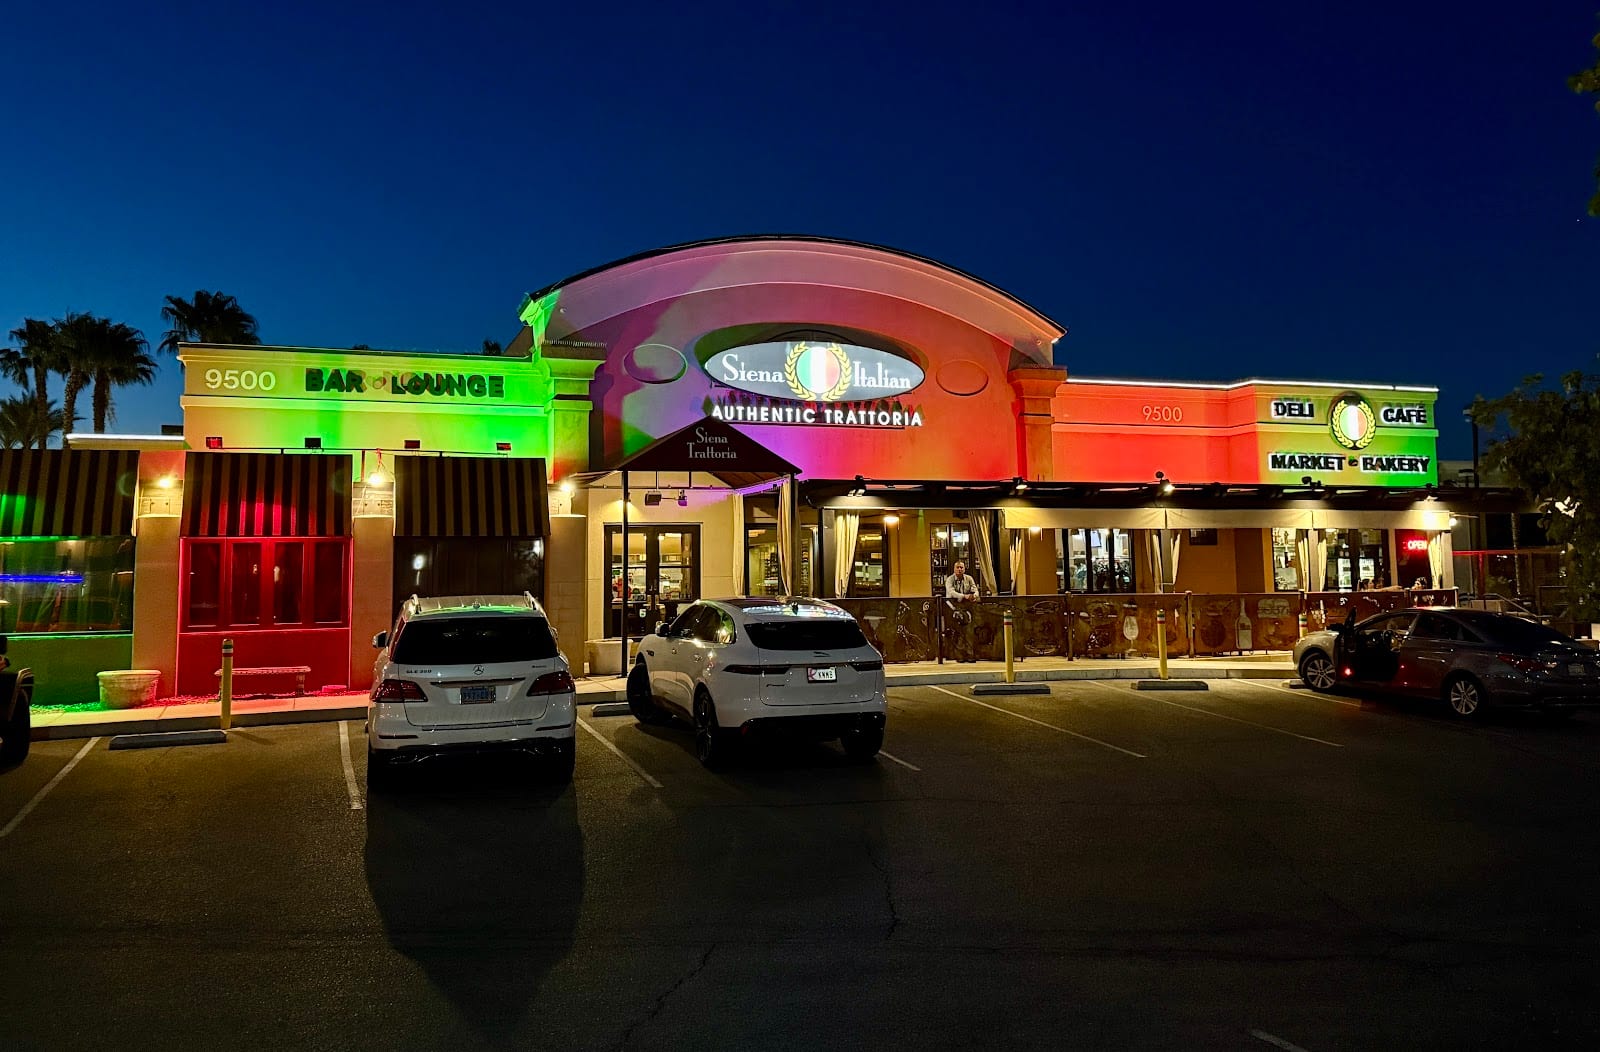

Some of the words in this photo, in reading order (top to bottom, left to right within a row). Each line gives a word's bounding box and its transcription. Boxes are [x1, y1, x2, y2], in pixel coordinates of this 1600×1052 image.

[205, 368, 276, 391] 9500
[721, 353, 786, 383] Siena
[852, 360, 911, 389] Italian
[305, 367, 364, 393] BAR
[391, 373, 505, 398] LOUNGE
[711, 405, 816, 424] AUTHENTIC
[824, 409, 923, 427] TRATTORIA
[1142, 405, 1183, 422] 9500
[1273, 402, 1314, 418] DELI
[695, 426, 728, 444] Siena
[687, 442, 738, 459] Trattoria
[1270, 454, 1346, 471] MARKET
[1361, 456, 1430, 473] BAKERY
[1407, 540, 1428, 550] OPEN
